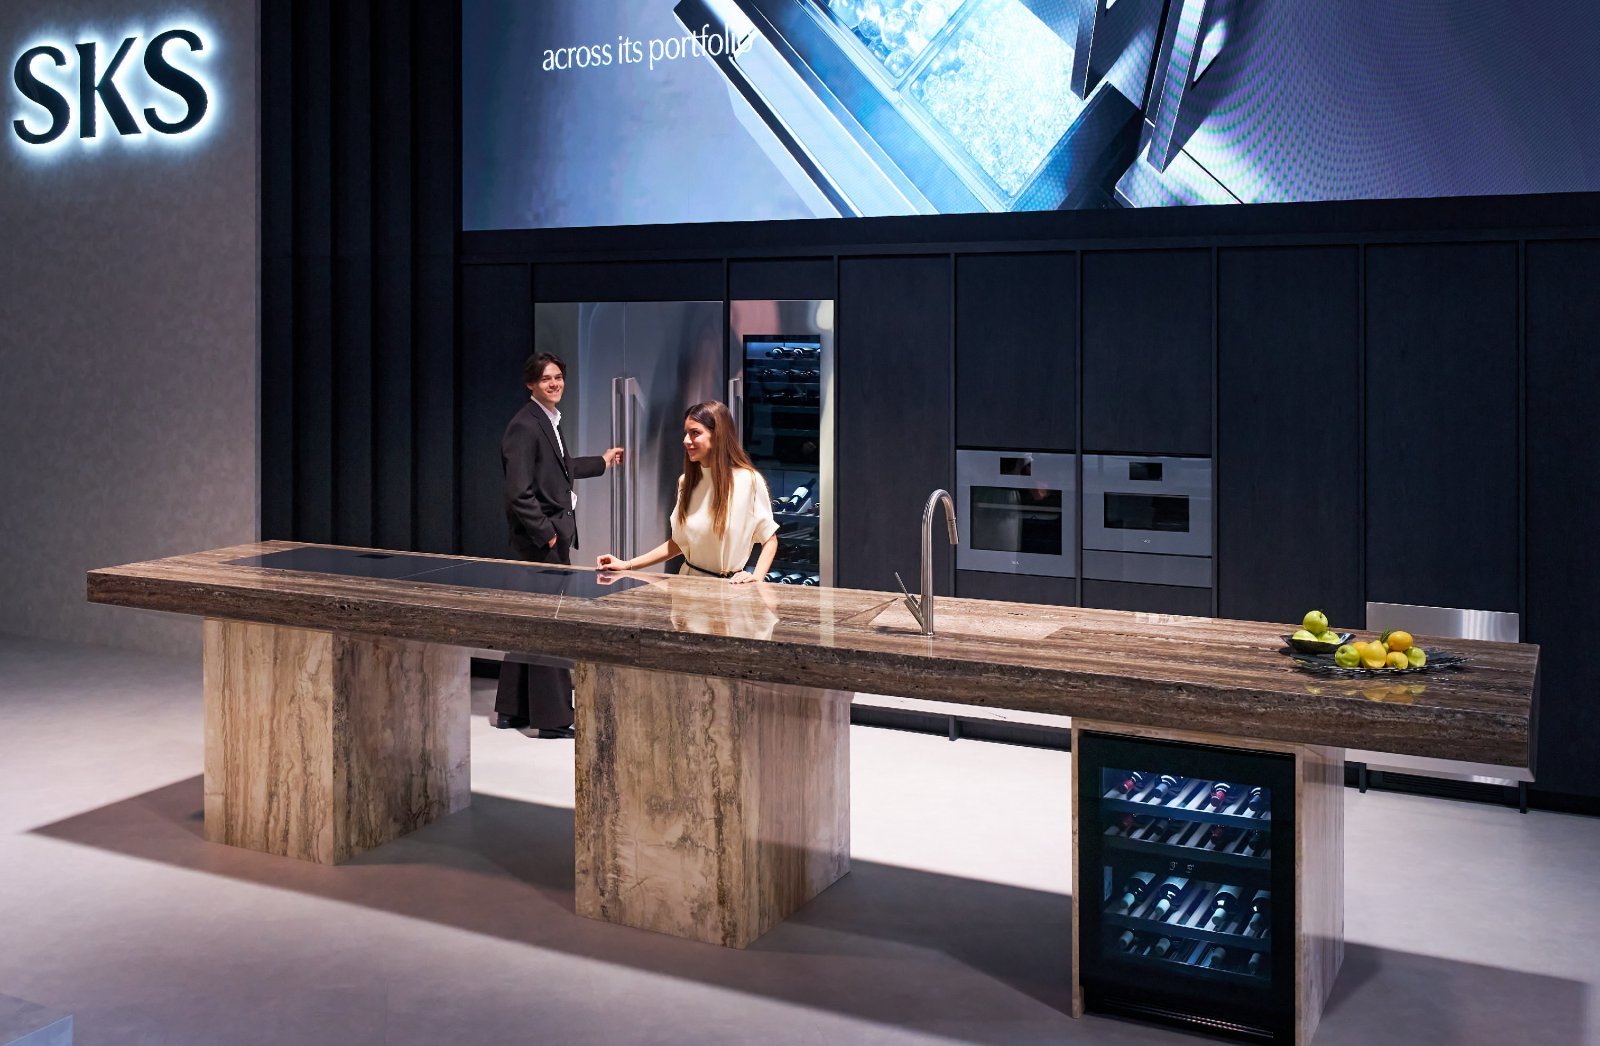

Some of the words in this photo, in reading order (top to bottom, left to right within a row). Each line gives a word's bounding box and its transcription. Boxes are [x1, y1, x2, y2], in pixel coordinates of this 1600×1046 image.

[13, 29, 208, 144] SKS
[542, 43, 613, 71] across
[618, 35, 643, 64] its
[649, 23, 754, 71] portfolio
